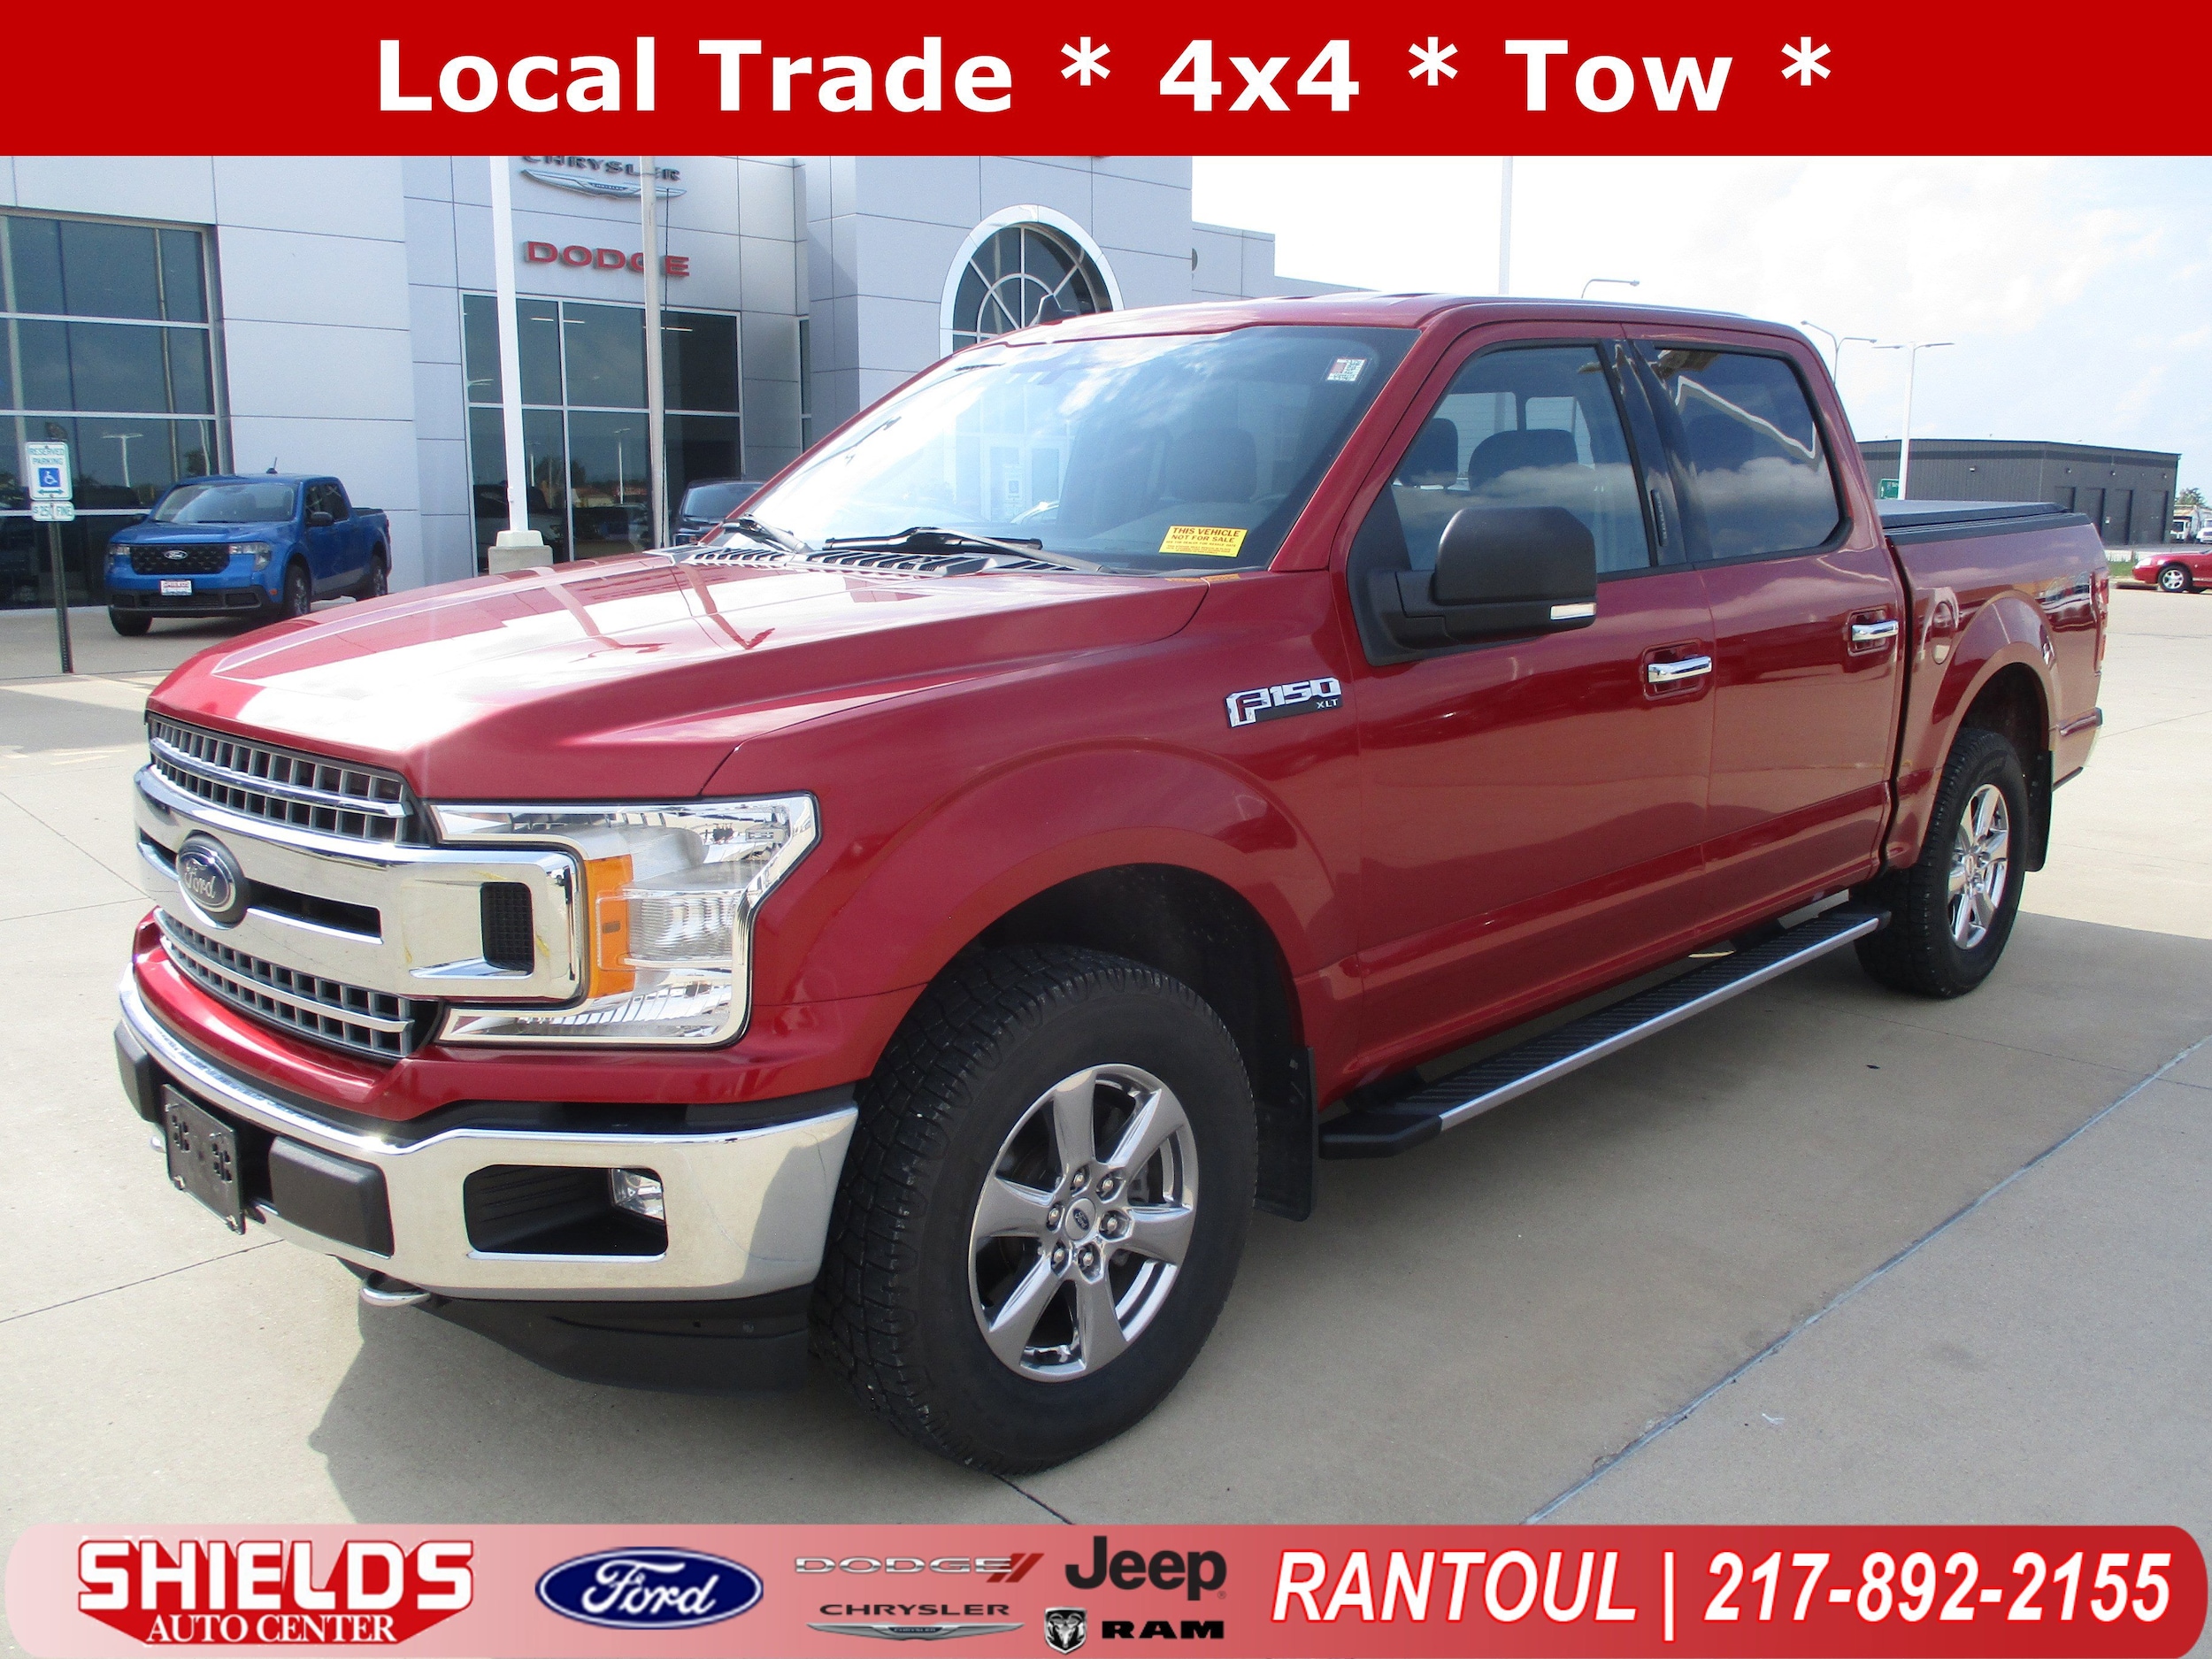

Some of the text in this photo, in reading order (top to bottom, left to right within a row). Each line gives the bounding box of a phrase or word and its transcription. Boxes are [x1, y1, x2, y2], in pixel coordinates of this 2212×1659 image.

[56, 505, 73, 517] FINE
[1198, 528, 1240, 537] VEHICLE
[1317, 698, 1339, 710] XLT
[183, 858, 217, 898] Ford
